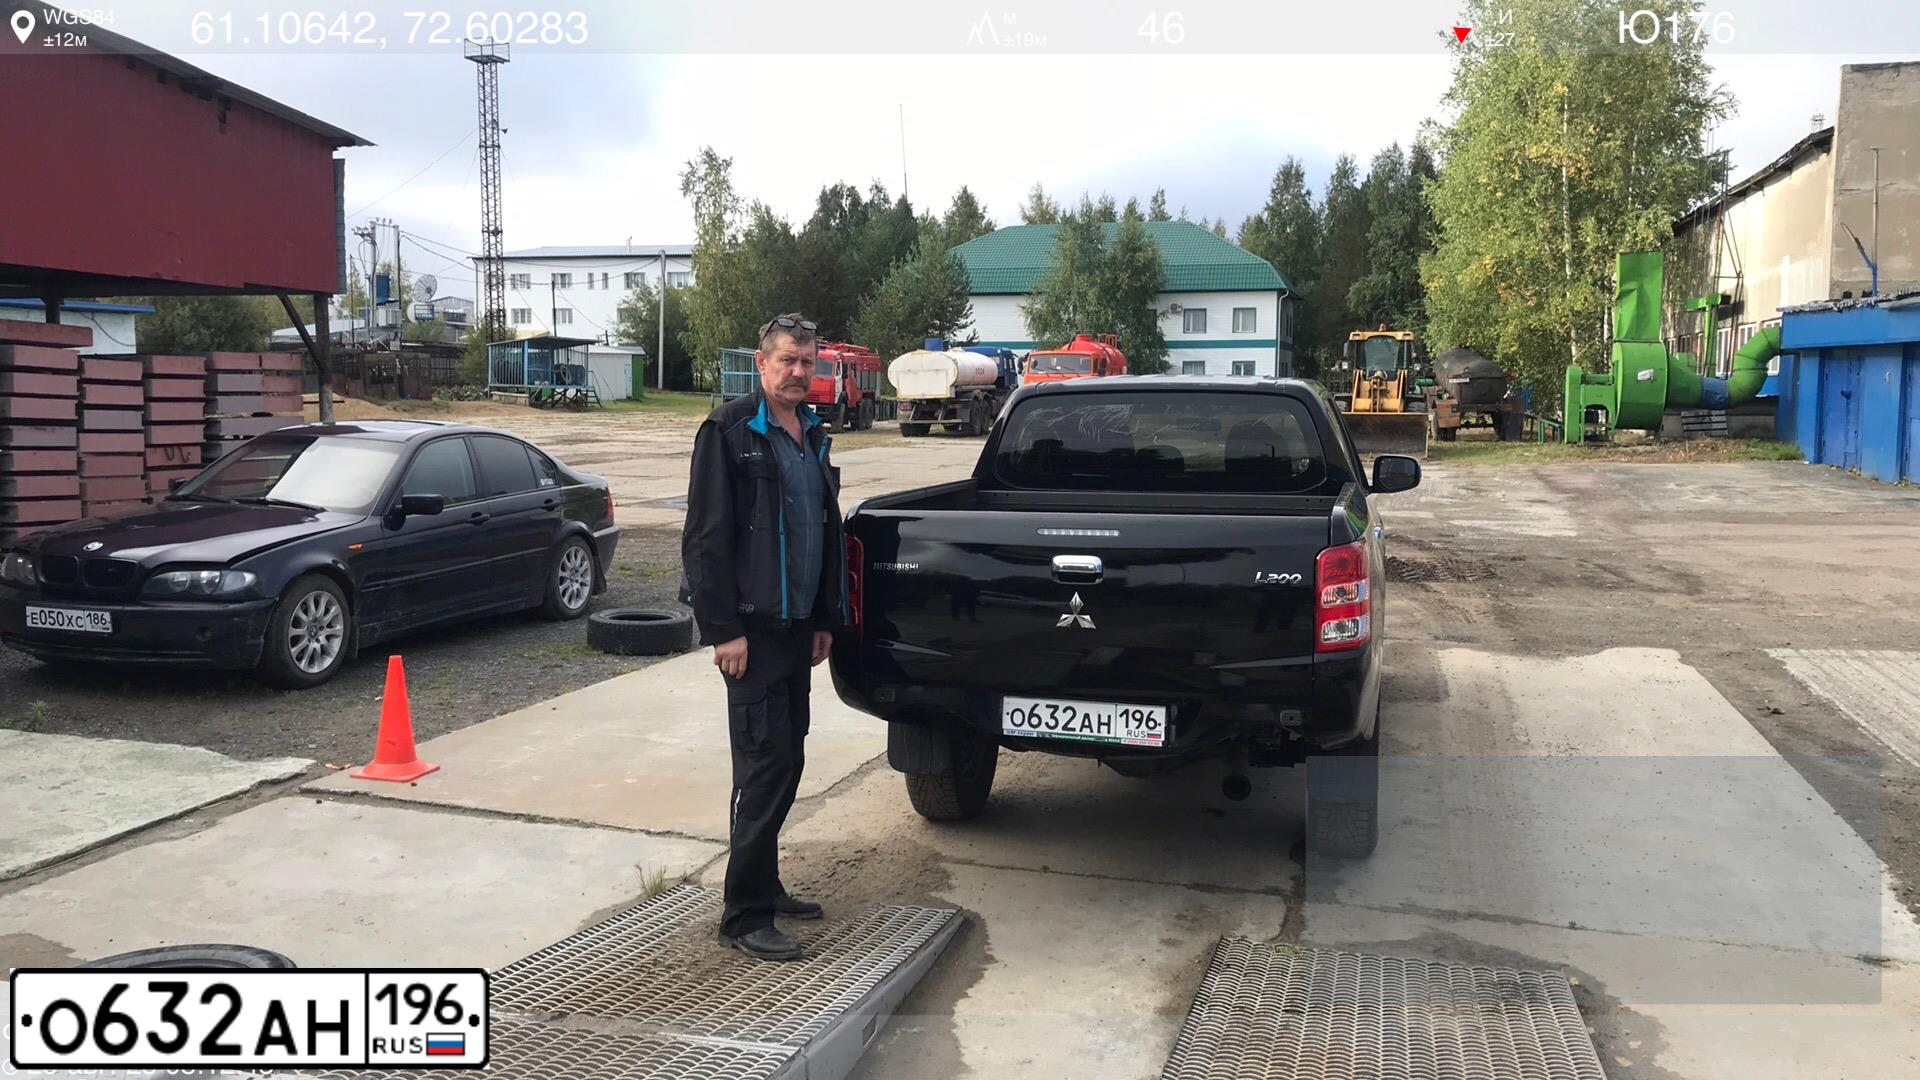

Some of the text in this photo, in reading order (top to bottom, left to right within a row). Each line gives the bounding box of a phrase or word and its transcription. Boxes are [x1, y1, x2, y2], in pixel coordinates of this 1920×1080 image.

[872, 562, 920, 571] MITSUBISHI
[1254, 571, 1303, 584] L200
[86, 612, 107, 626] 186
[1118, 708, 1159, 731] 196
[1126, 729, 1146, 740] RUS
